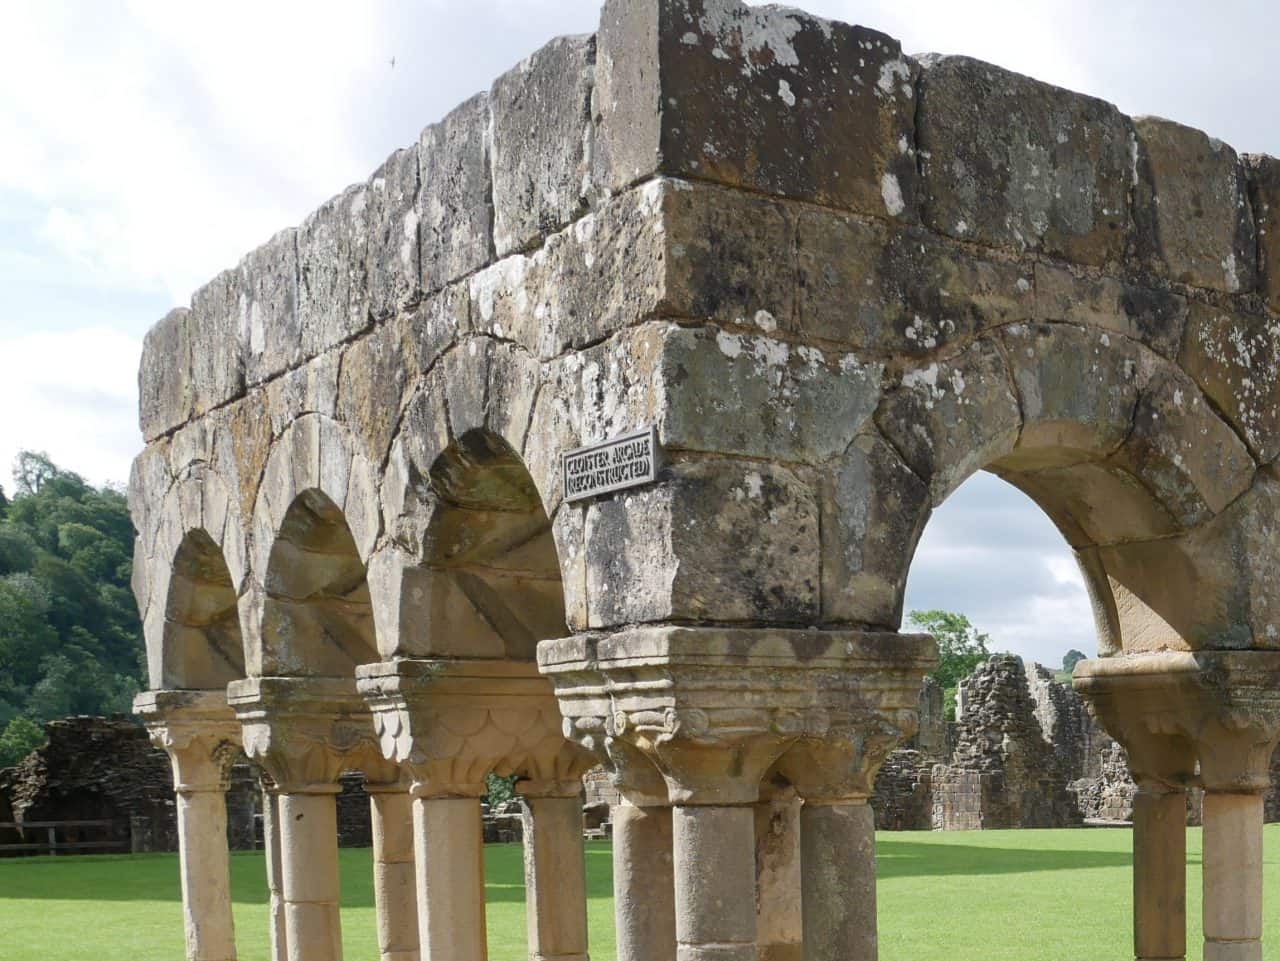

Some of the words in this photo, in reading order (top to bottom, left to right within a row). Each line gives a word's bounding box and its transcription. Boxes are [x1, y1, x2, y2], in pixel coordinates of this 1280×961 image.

[568, 451, 610, 475] CLOISTER
[613, 439, 650, 465] ARCADE
[567, 457, 650, 495] (RECONSTRUCTED)
